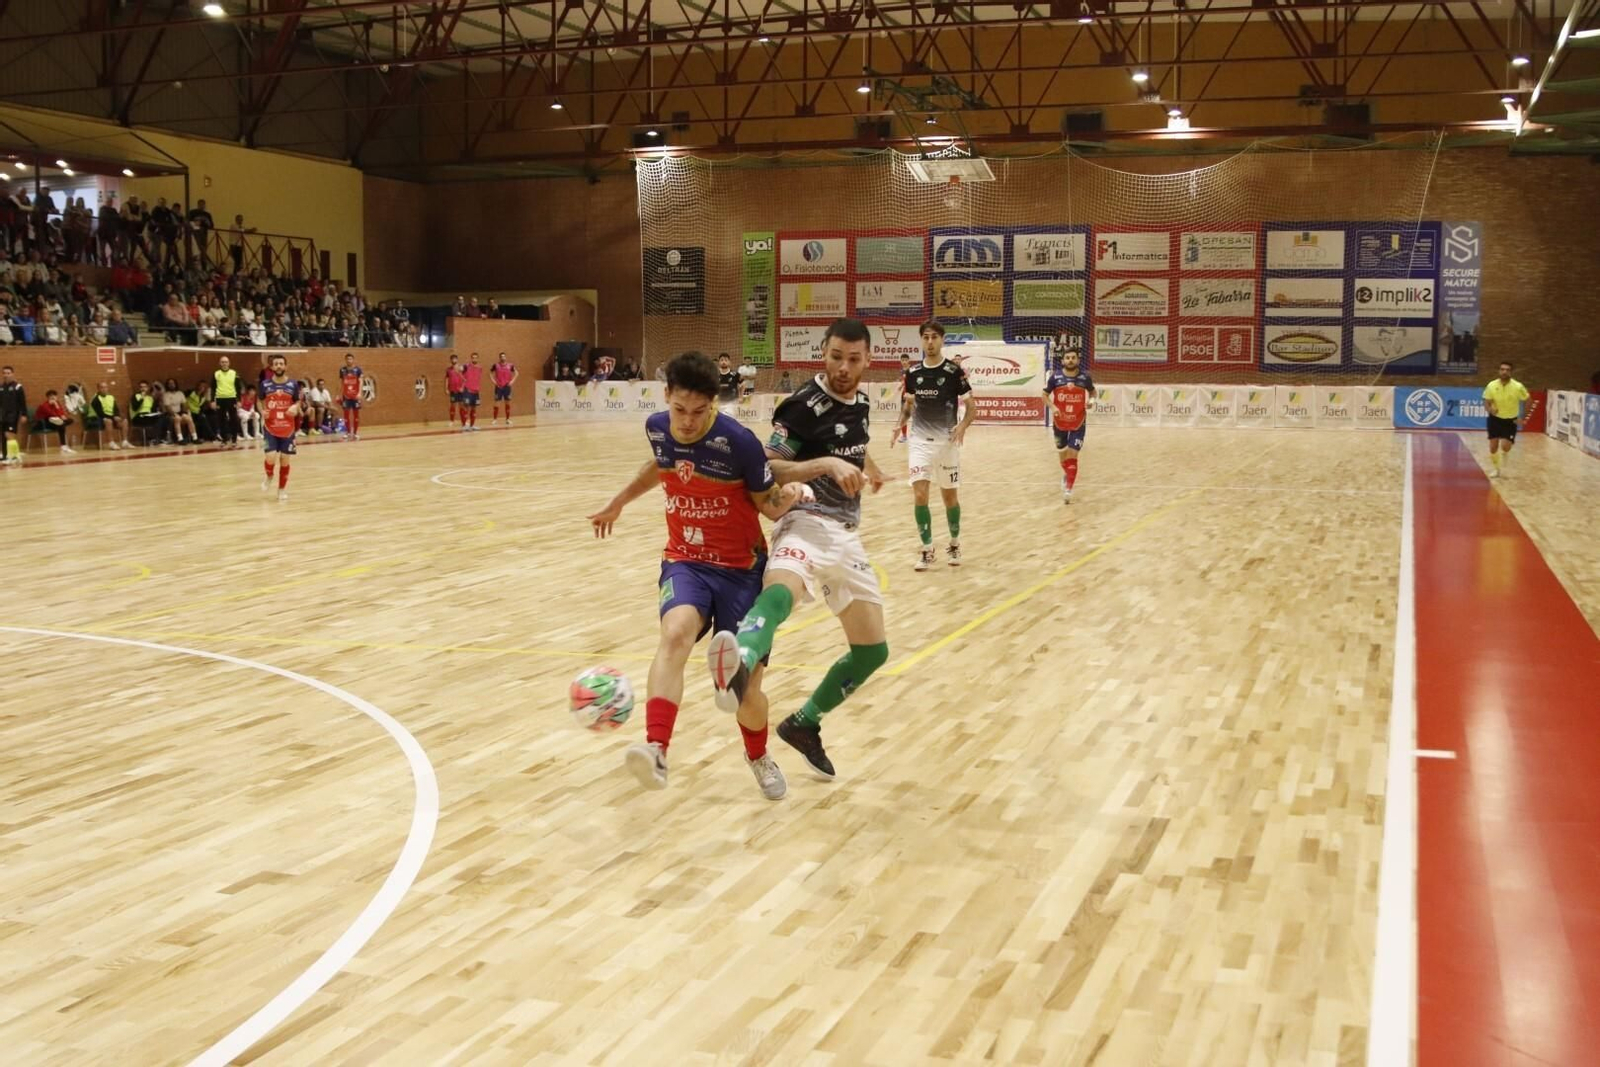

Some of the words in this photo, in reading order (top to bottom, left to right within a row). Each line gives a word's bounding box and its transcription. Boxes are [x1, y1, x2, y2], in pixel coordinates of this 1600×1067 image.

[1025, 237, 1072, 250] Francis
[795, 263, 845, 274] Fisioterapia
[1443, 269, 1480, 277] SECURE
[1444, 279, 1477, 287] MATCH
[1375, 287, 1433, 306] implik2
[1122, 333, 1167, 347] ZAPA
[874, 345, 920, 355] Despensa
[1182, 345, 1214, 355] PSOE
[990, 409, 1039, 417] EQUIPAZO
[949, 472, 959, 482] 12
[680, 508, 729, 519] innova
